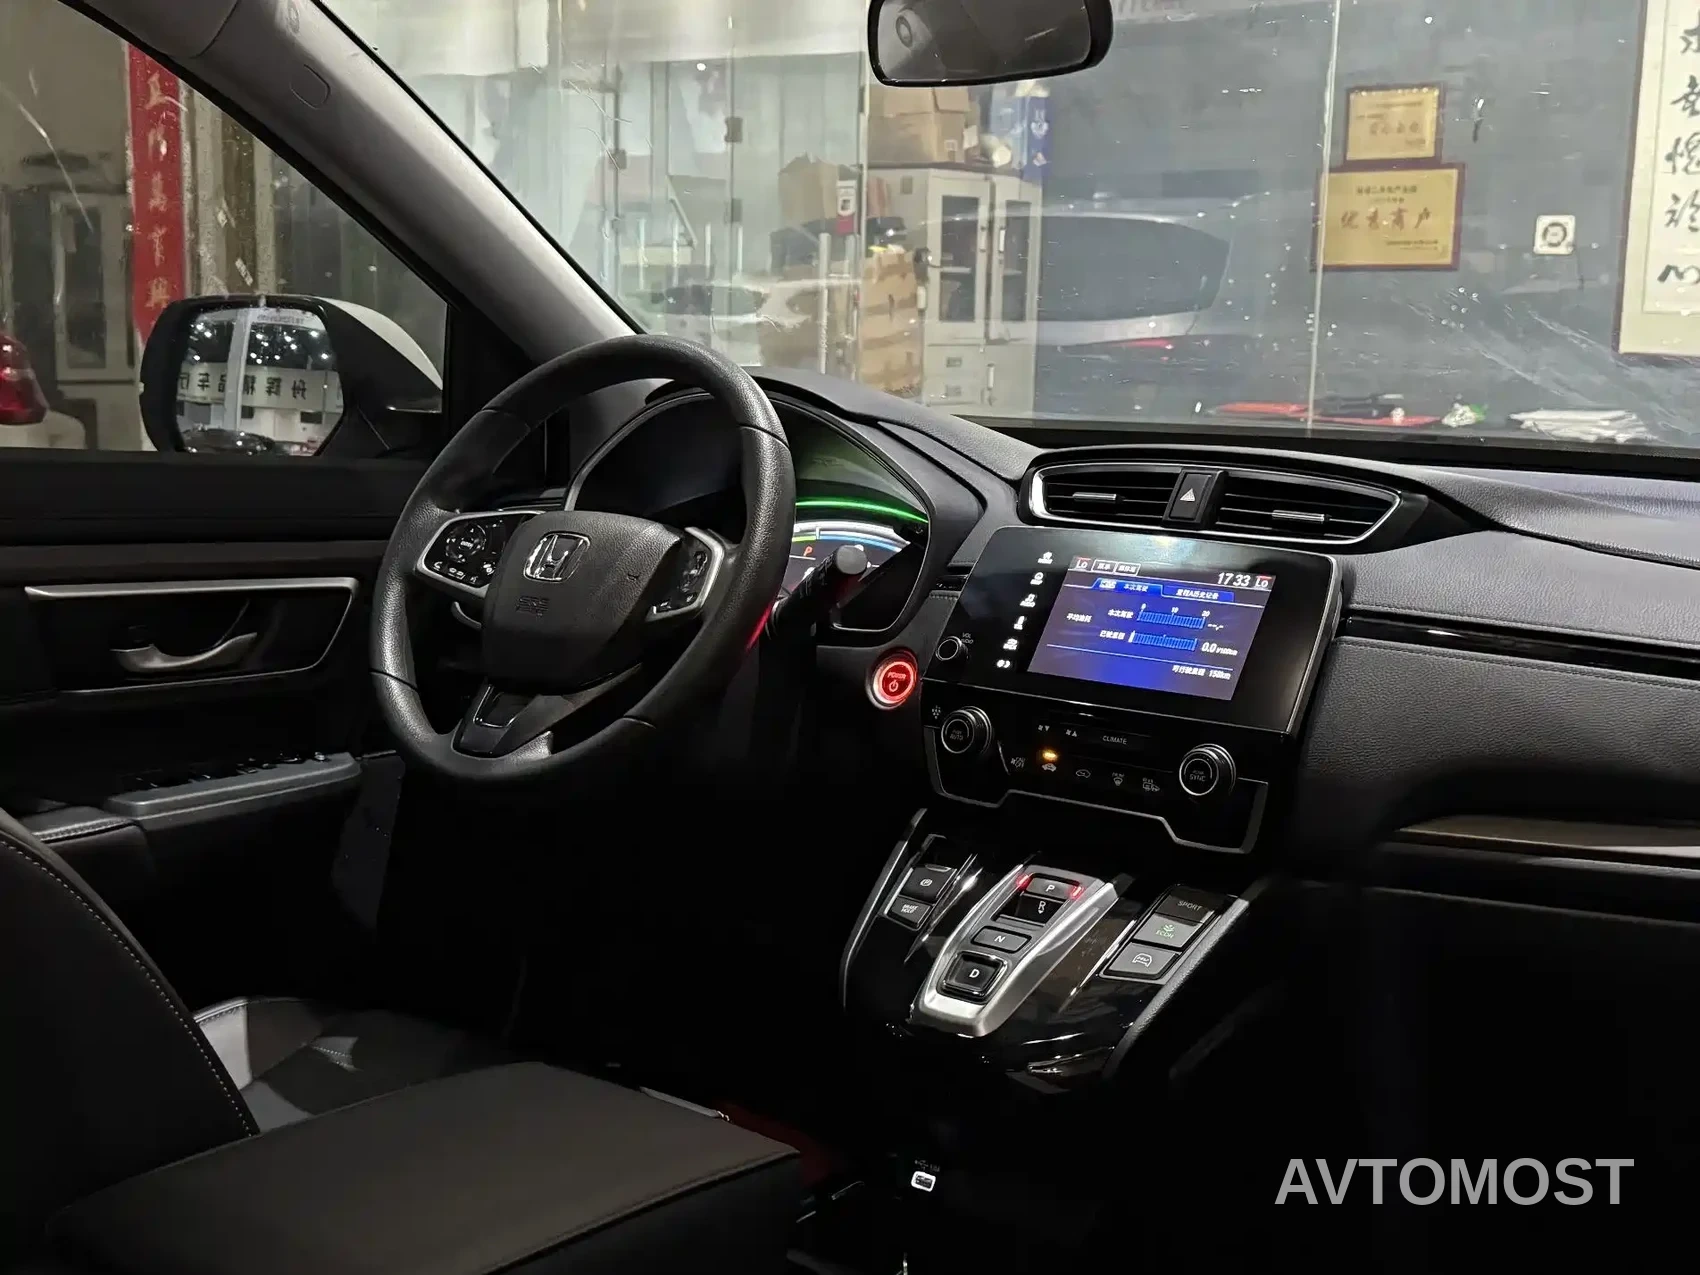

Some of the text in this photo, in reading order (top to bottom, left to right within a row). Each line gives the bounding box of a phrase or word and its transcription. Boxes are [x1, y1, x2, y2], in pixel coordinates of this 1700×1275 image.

[1201, 642, 1217, 653] 0.0
[1102, 735, 1127, 745] CLIMATE
[1045, 884, 1055, 892] P
[1038, 900, 1046, 910] R
[1177, 901, 1203, 911] SPORT
[1155, 929, 1176, 939] ECON
[969, 969, 980, 978] D
